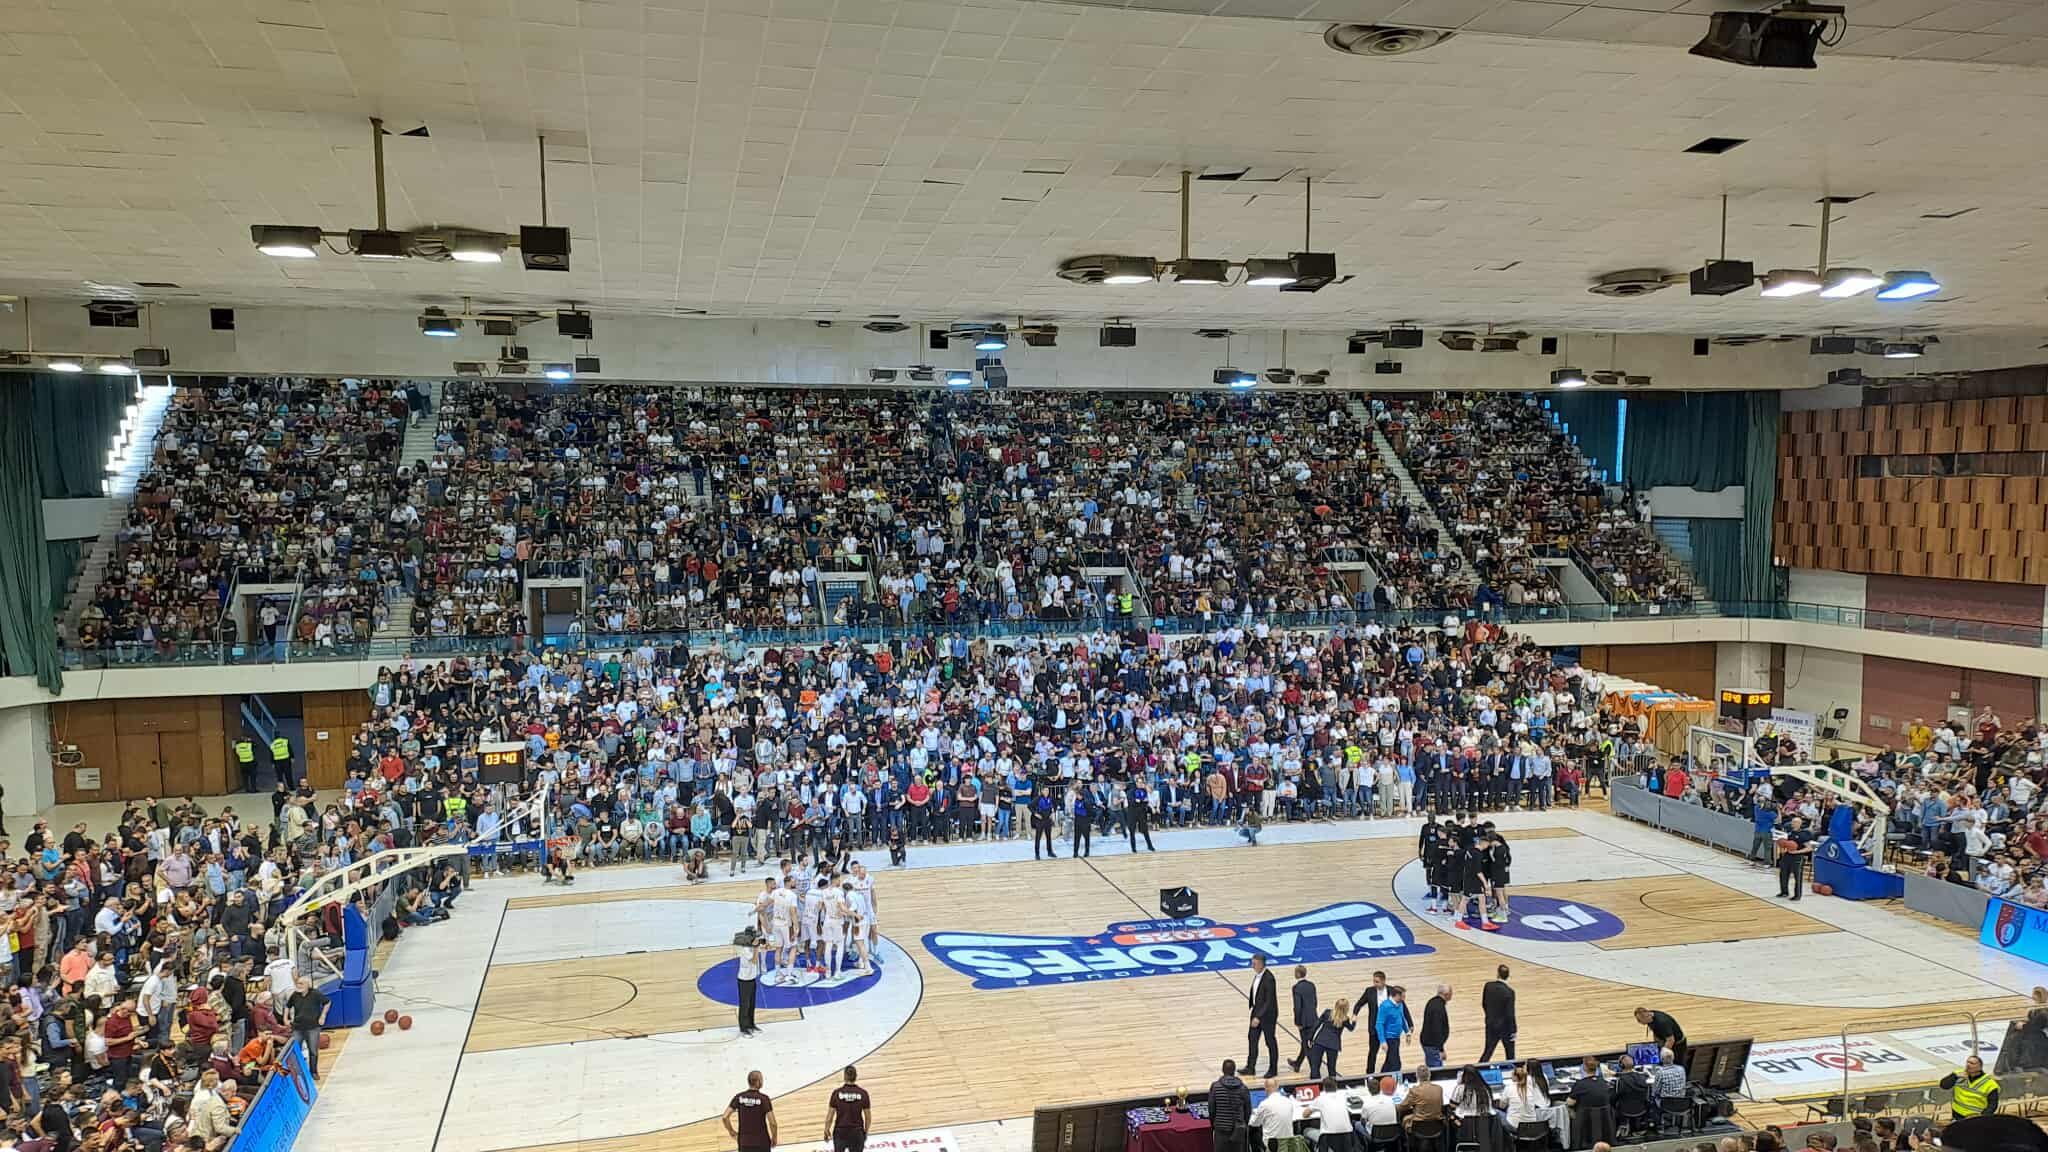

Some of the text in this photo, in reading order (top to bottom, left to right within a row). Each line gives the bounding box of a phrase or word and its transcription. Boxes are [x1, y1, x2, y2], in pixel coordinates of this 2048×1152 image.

[1135, 928, 1216, 943] 2025
[947, 916, 1406, 979] PLAYOFFS
[1331, 949, 1397, 959] NLB
[1057, 964, 1209, 983] LEAGUE
